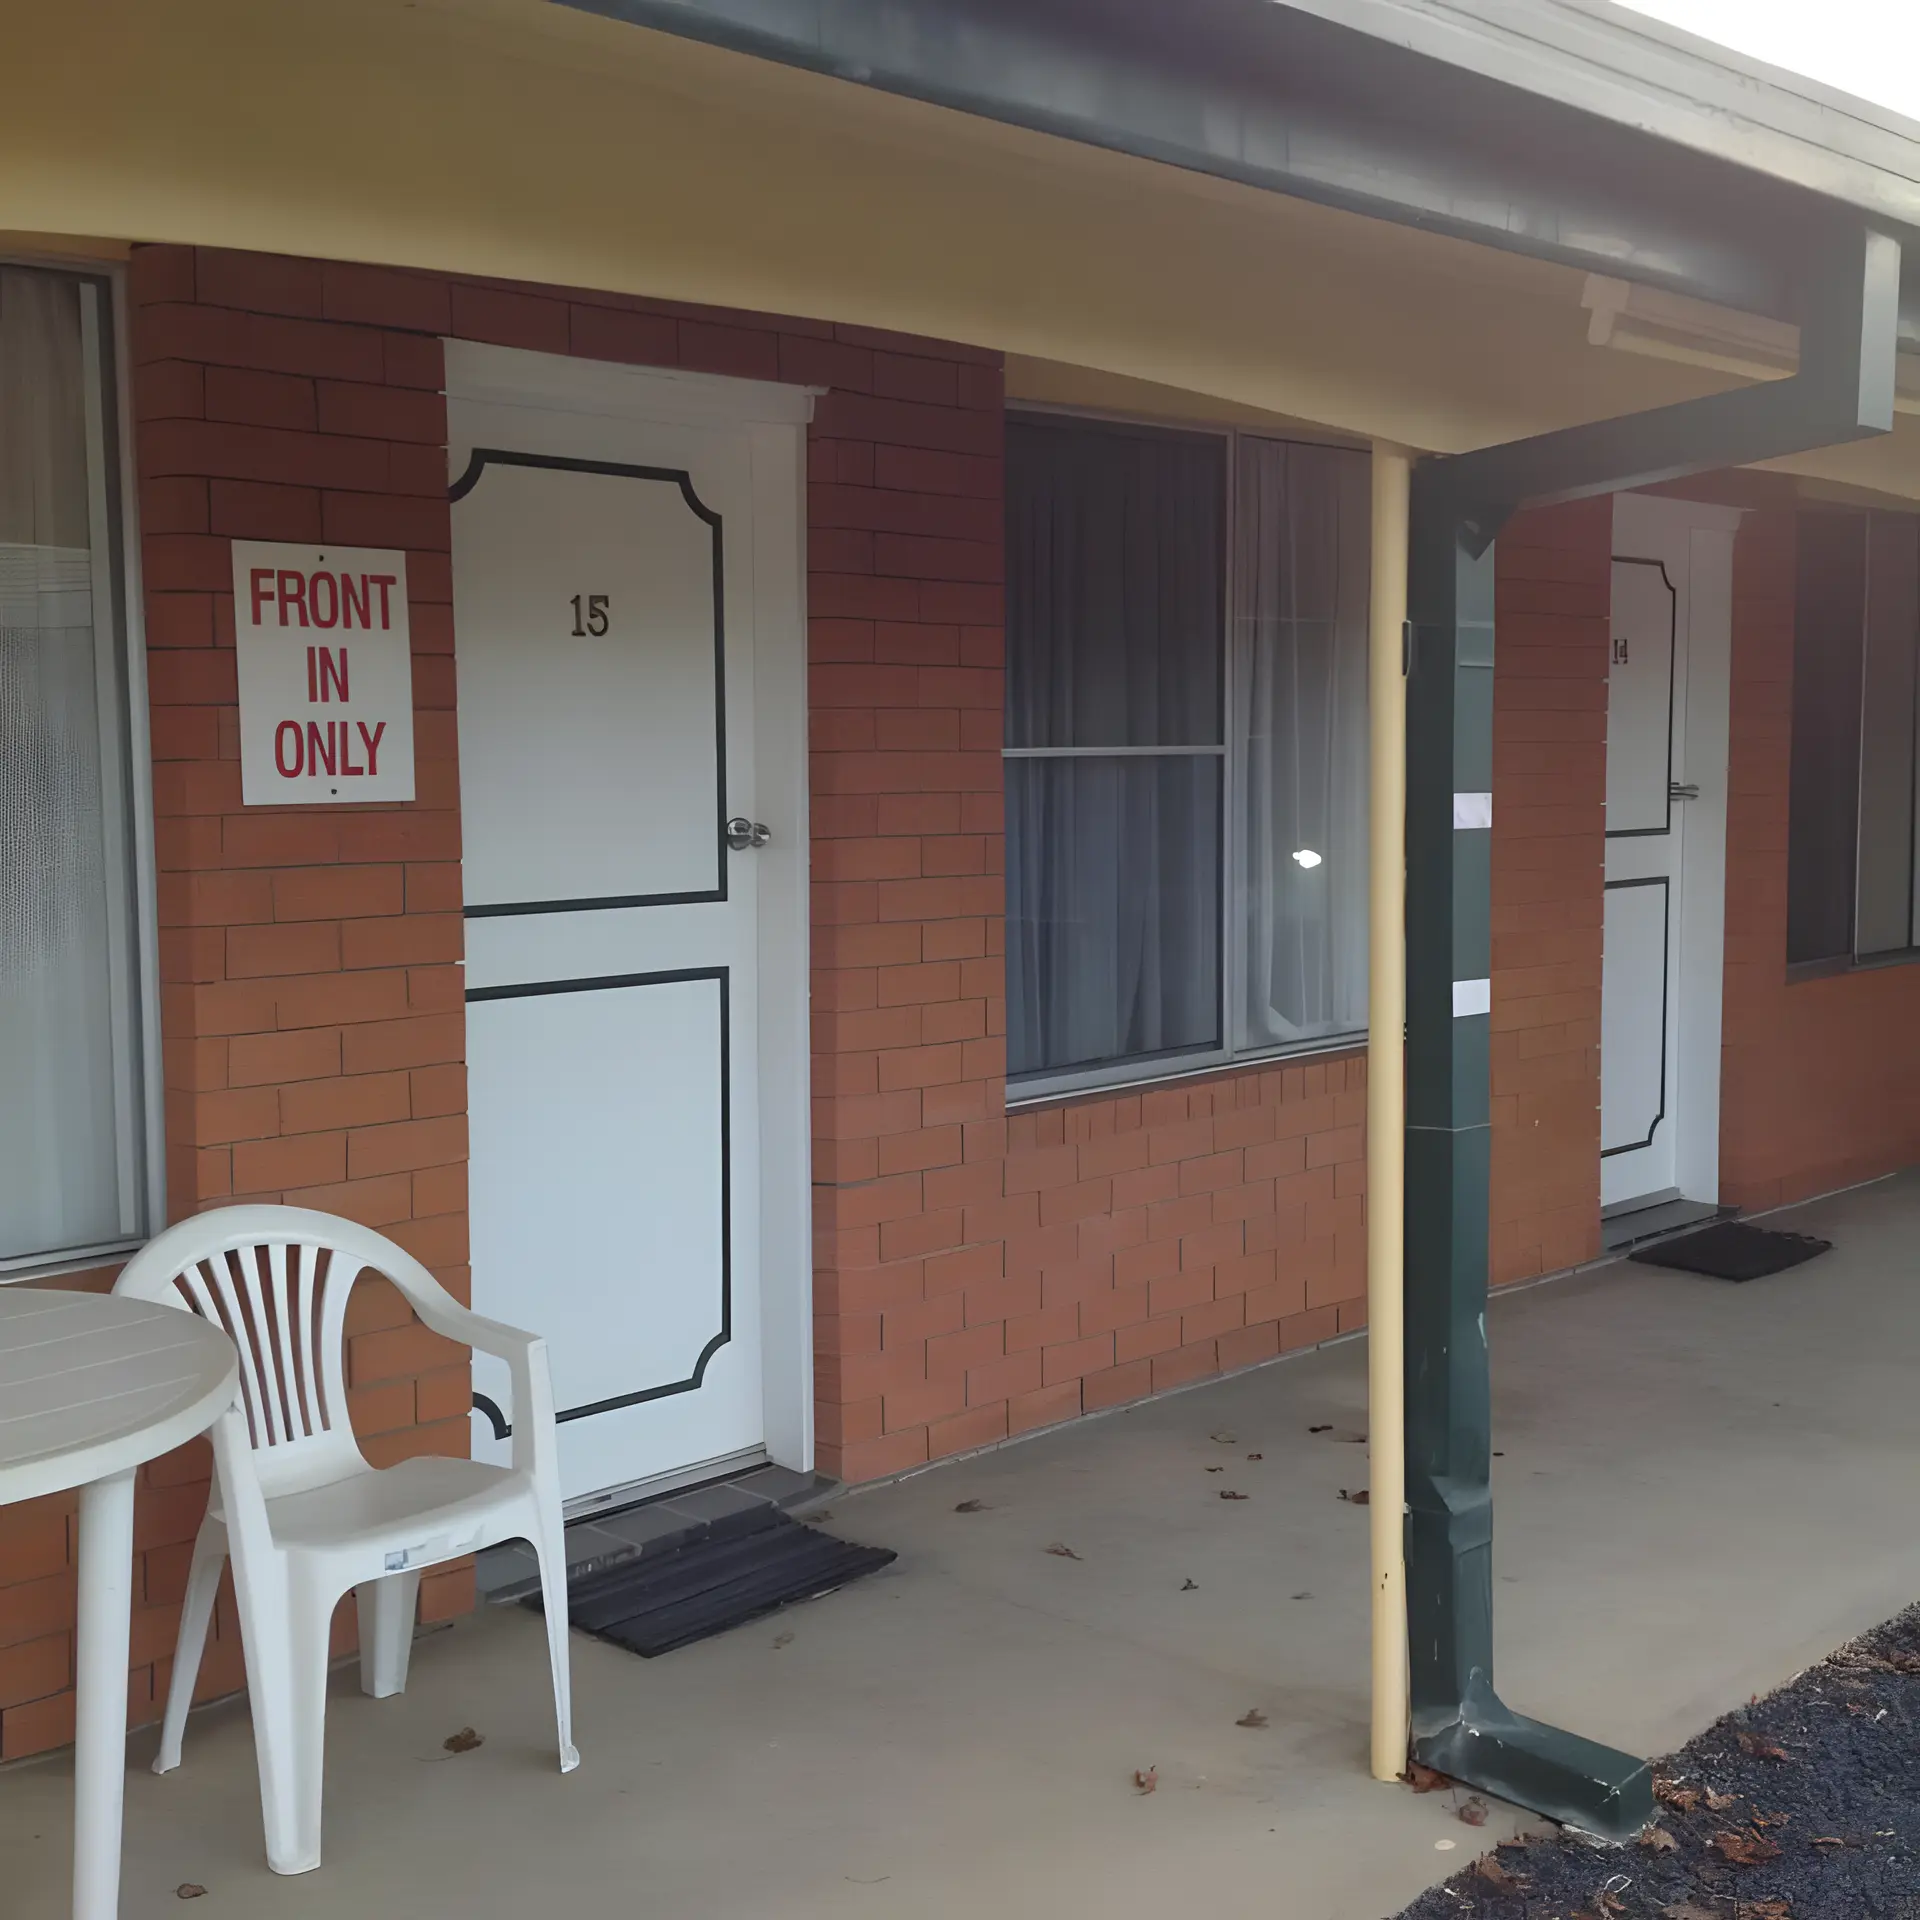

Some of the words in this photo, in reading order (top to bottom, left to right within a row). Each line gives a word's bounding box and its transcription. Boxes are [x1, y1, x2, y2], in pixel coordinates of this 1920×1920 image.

[251, 569, 397, 630] FRONT
[570, 594, 610, 637] 15
[307, 646, 350, 703] IN
[275, 720, 387, 778] ONLY
